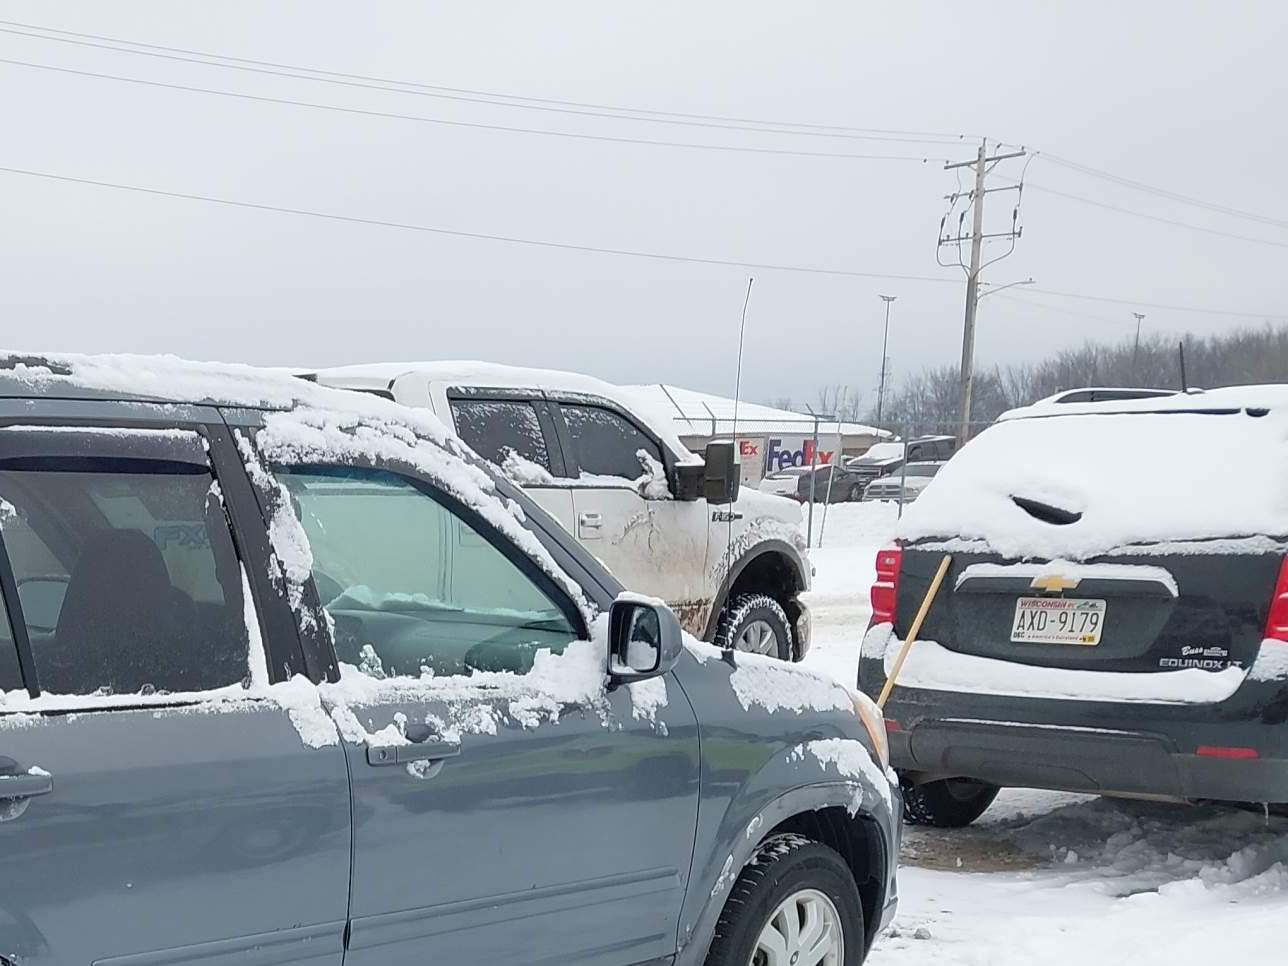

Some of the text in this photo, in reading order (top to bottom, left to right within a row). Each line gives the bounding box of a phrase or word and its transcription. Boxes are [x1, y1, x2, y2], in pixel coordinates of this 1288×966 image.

[767, 439, 834, 472] FedEx
[1019, 599, 1067, 609] WISCONSIN
[1015, 610, 1100, 633] AXD-9179
[1013, 631, 1025, 639] DEC
[1159, 657, 1224, 669] EQUINOX
